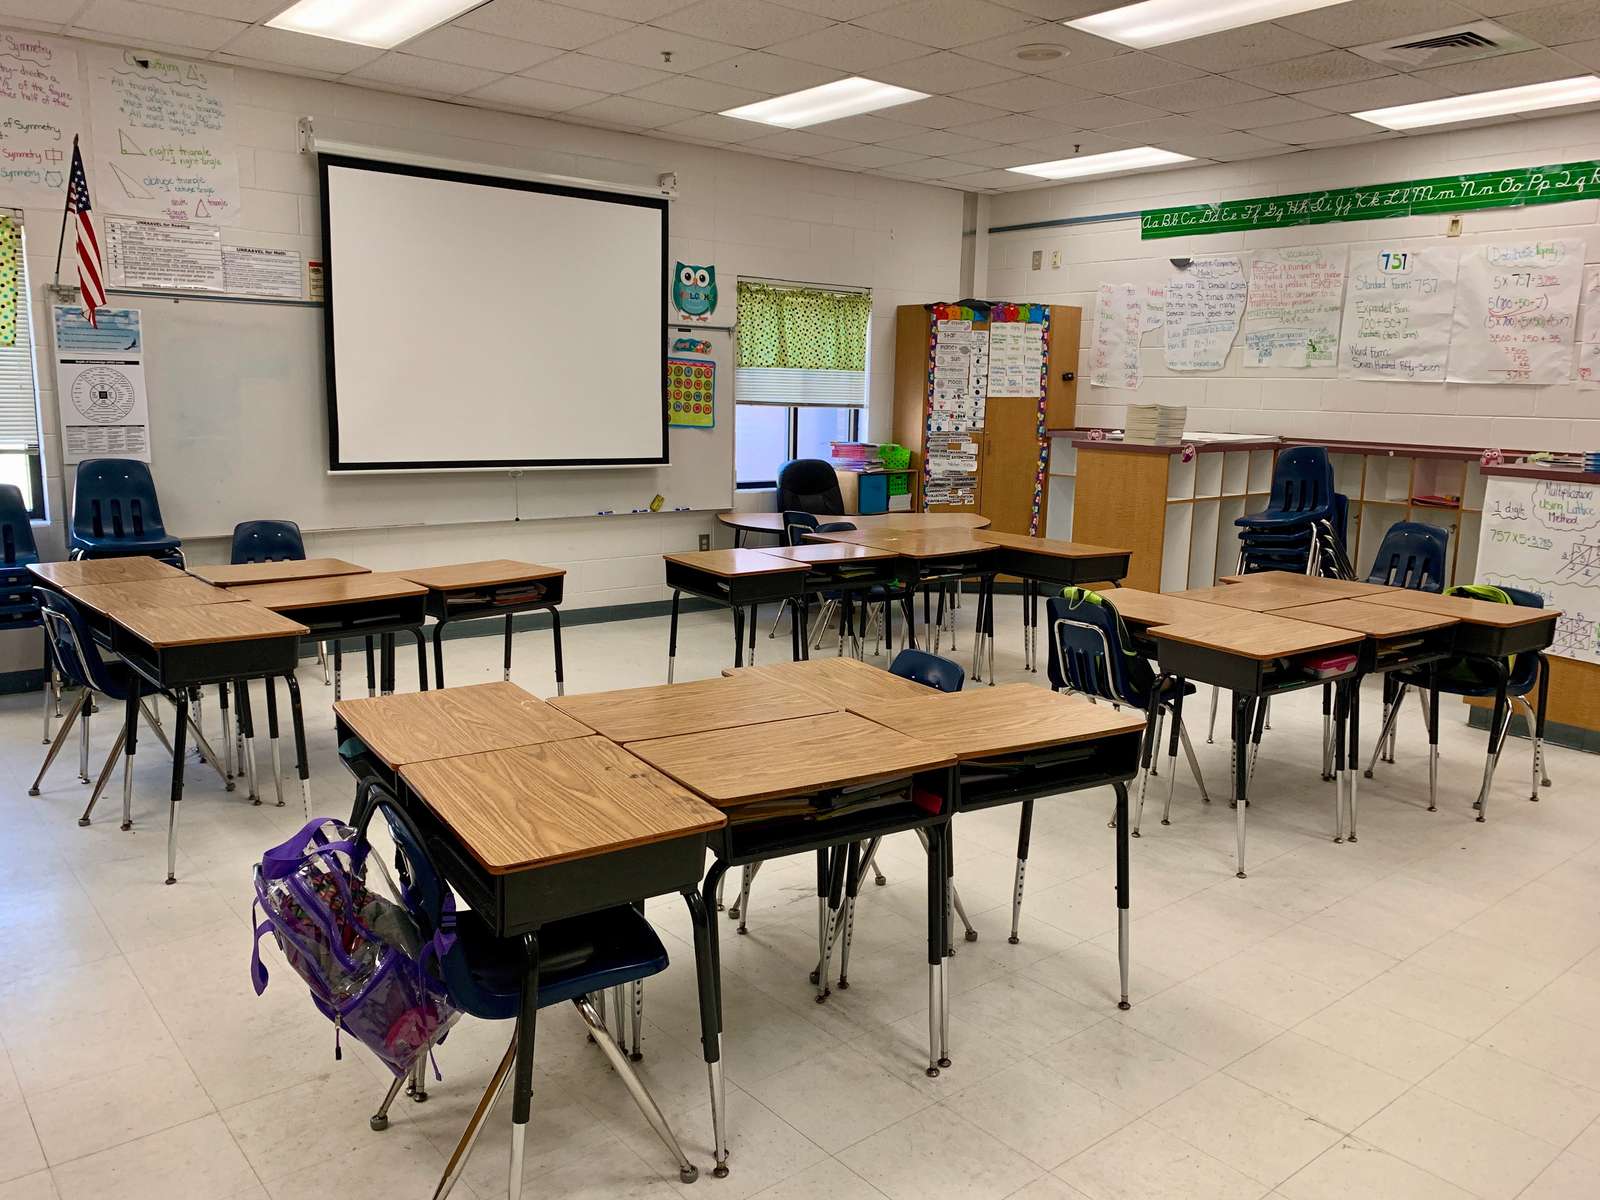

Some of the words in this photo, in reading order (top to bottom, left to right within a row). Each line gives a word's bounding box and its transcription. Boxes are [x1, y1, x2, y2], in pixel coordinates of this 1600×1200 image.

[4, 117, 13, 129] of
[14, 119, 61, 141] Symmetry
[2, 147, 42, 165] Symmetry
[1142, 215, 1159, 229] Aa
[1161, 213, 1177, 227] Bb
[1180, 211, 1196, 225] Cc
[1199, 207, 1219, 223] Dd
[1221, 209, 1237, 221] Ee
[1241, 204, 1259, 224] Ff
[1264, 203, 1283, 222] Gg
[1287, 200, 1308, 214] Hh
[1334, 195, 1352, 216] Jj
[1356, 192, 1380, 208] Kk
[1383, 189, 1409, 206] Ll
[1412, 185, 1455, 202] Mm
[1460, 180, 1494, 197] Nn
[1499, 176, 1524, 193] Oo
[1527, 173, 1550, 196] Pp
[1381, 253, 1408, 271] 757
[1414, 278, 1439, 294] 757
[1544, 480, 1593, 500] Multiplication
[1504, 501, 1525, 518] digit
[1548, 511, 1577, 525] Method
